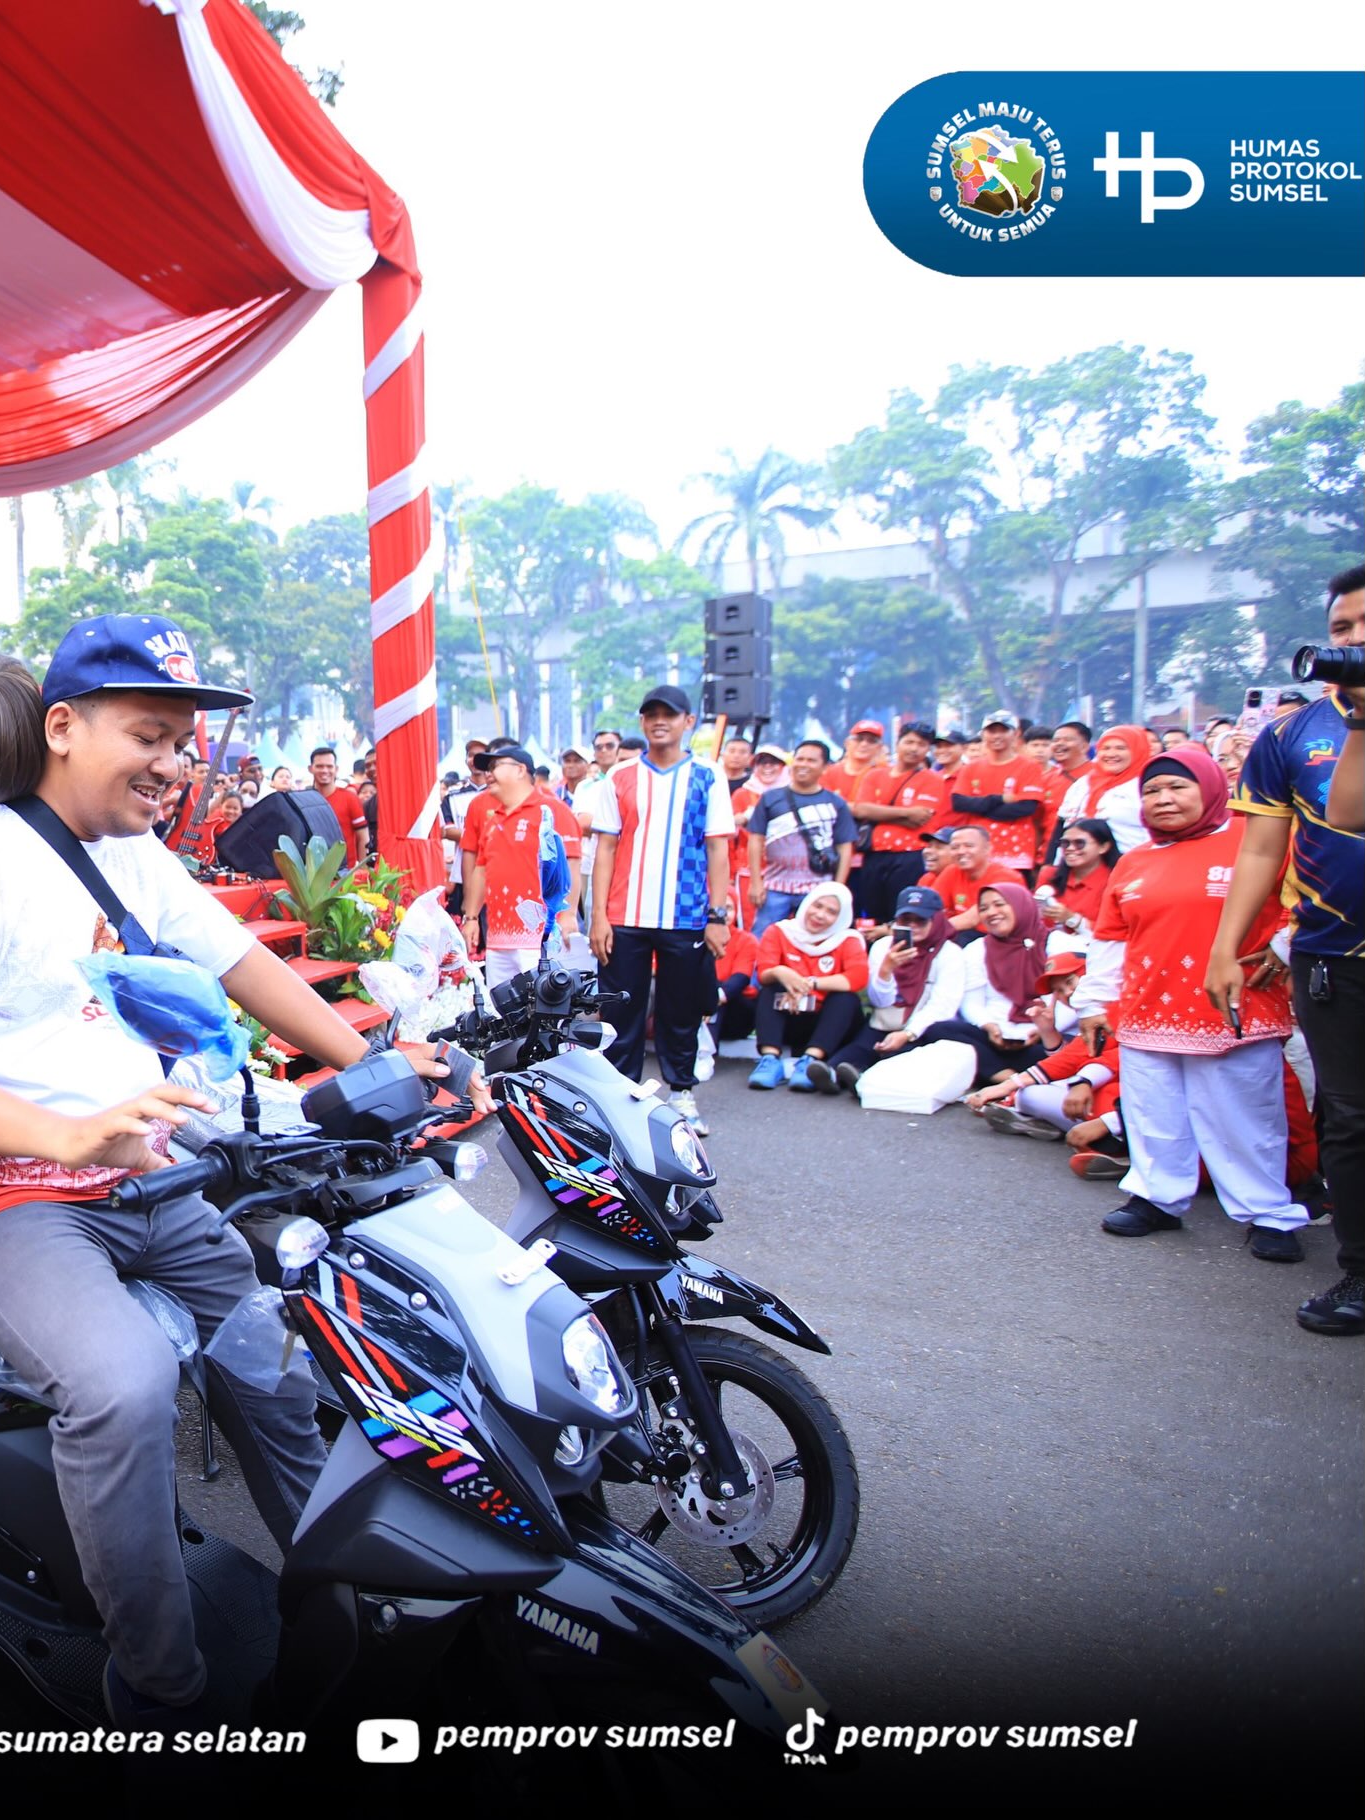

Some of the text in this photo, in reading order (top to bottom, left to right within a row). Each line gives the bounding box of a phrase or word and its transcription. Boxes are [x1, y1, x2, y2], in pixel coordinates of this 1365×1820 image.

[532, 1150, 627, 1201] 125
[680, 1274, 723, 1304] YAMAHA
[340, 1372, 485, 1462] 125
[516, 1594, 599, 1655] YAMAHA
